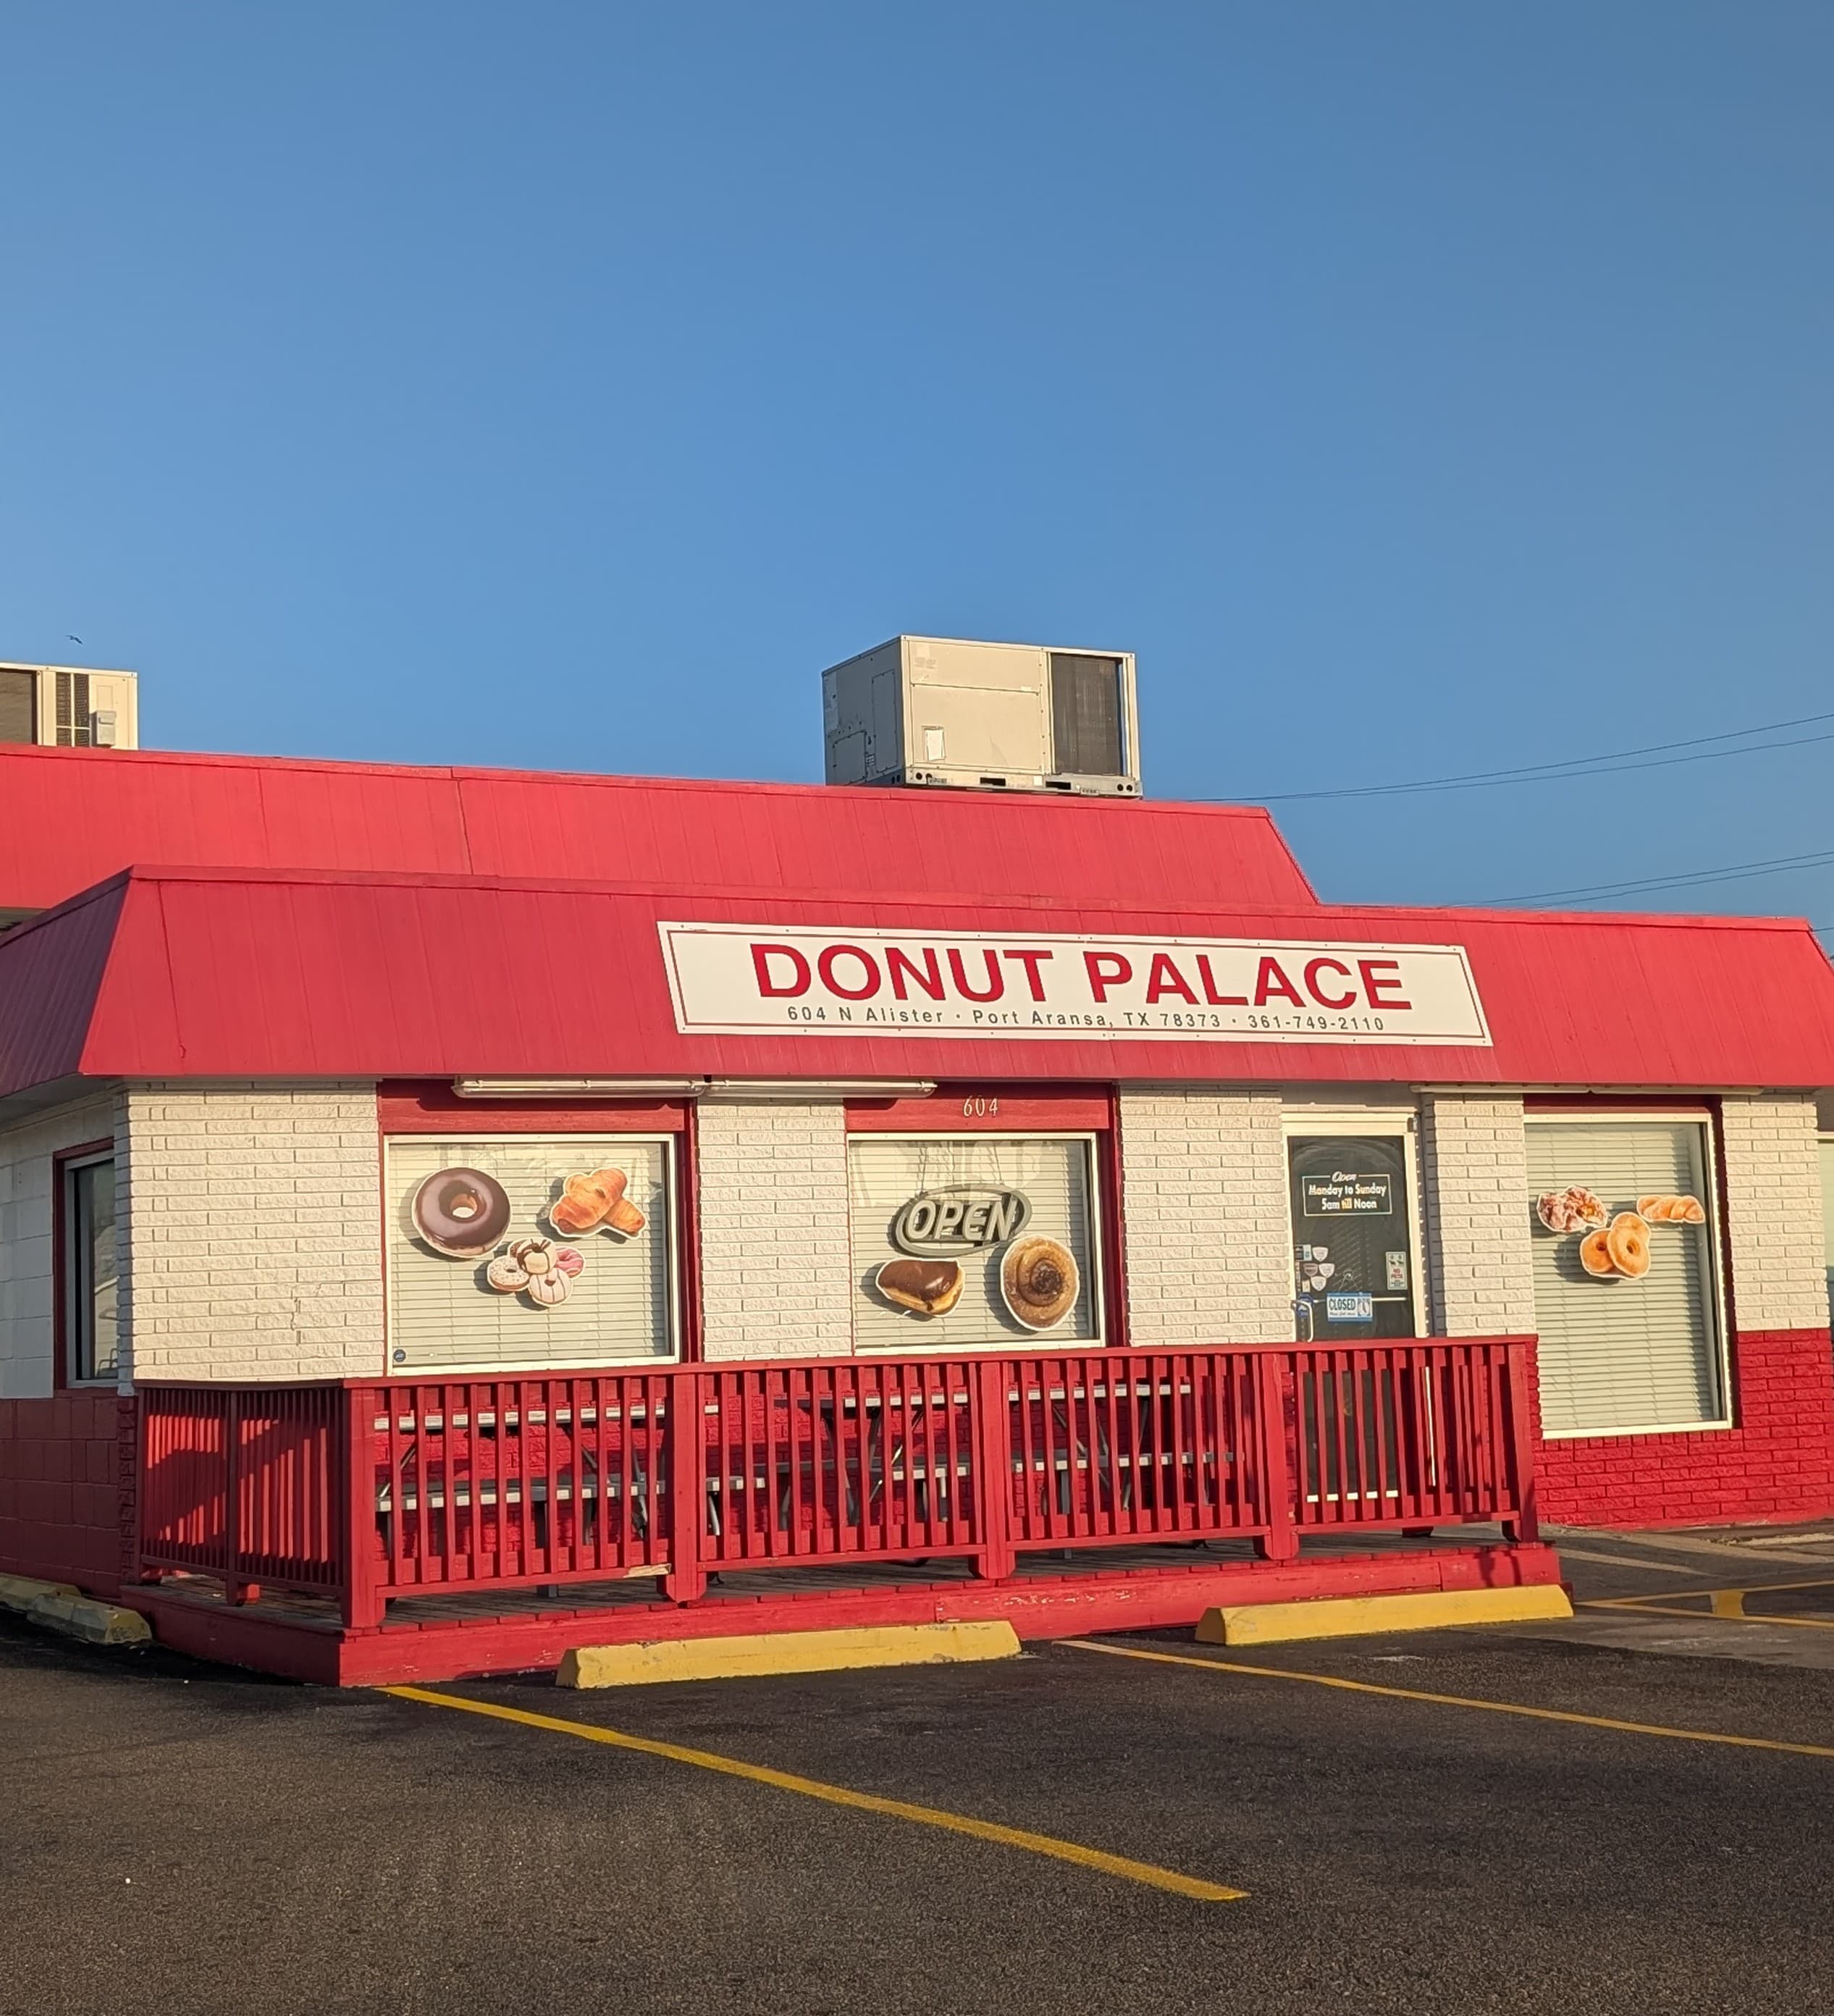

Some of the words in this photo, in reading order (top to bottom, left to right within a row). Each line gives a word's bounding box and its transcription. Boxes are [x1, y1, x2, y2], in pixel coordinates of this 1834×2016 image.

[749, 943, 1053, 1002] DONUT
[1082, 950, 1413, 1010] PALACE
[787, 1006, 826, 1021] 604
[838, 1007, 852, 1021] N
[865, 1007, 943, 1022] Alister
[972, 1009, 1019, 1024] Port
[1032, 1010, 1114, 1028] Aransa,
[1123, 1012, 1150, 1026] TX
[1159, 1013, 1221, 1028] 78373
[1248, 1015, 1384, 1030] 361-749-2110
[963, 1095, 998, 1117] 604
[1332, 1171, 1357, 1182] Open
[1308, 1183, 1343, 1198] Monday
[1345, 1185, 1353, 1194] to
[1355, 1182, 1387, 1197] Sunday
[1321, 1198, 1340, 1210] 5am
[1341, 1198, 1353, 1209] till
[1354, 1198, 1377, 1209] Noon
[907, 1196, 1018, 1240] OPEN
[1329, 1298, 1356, 1311] CLOSED
